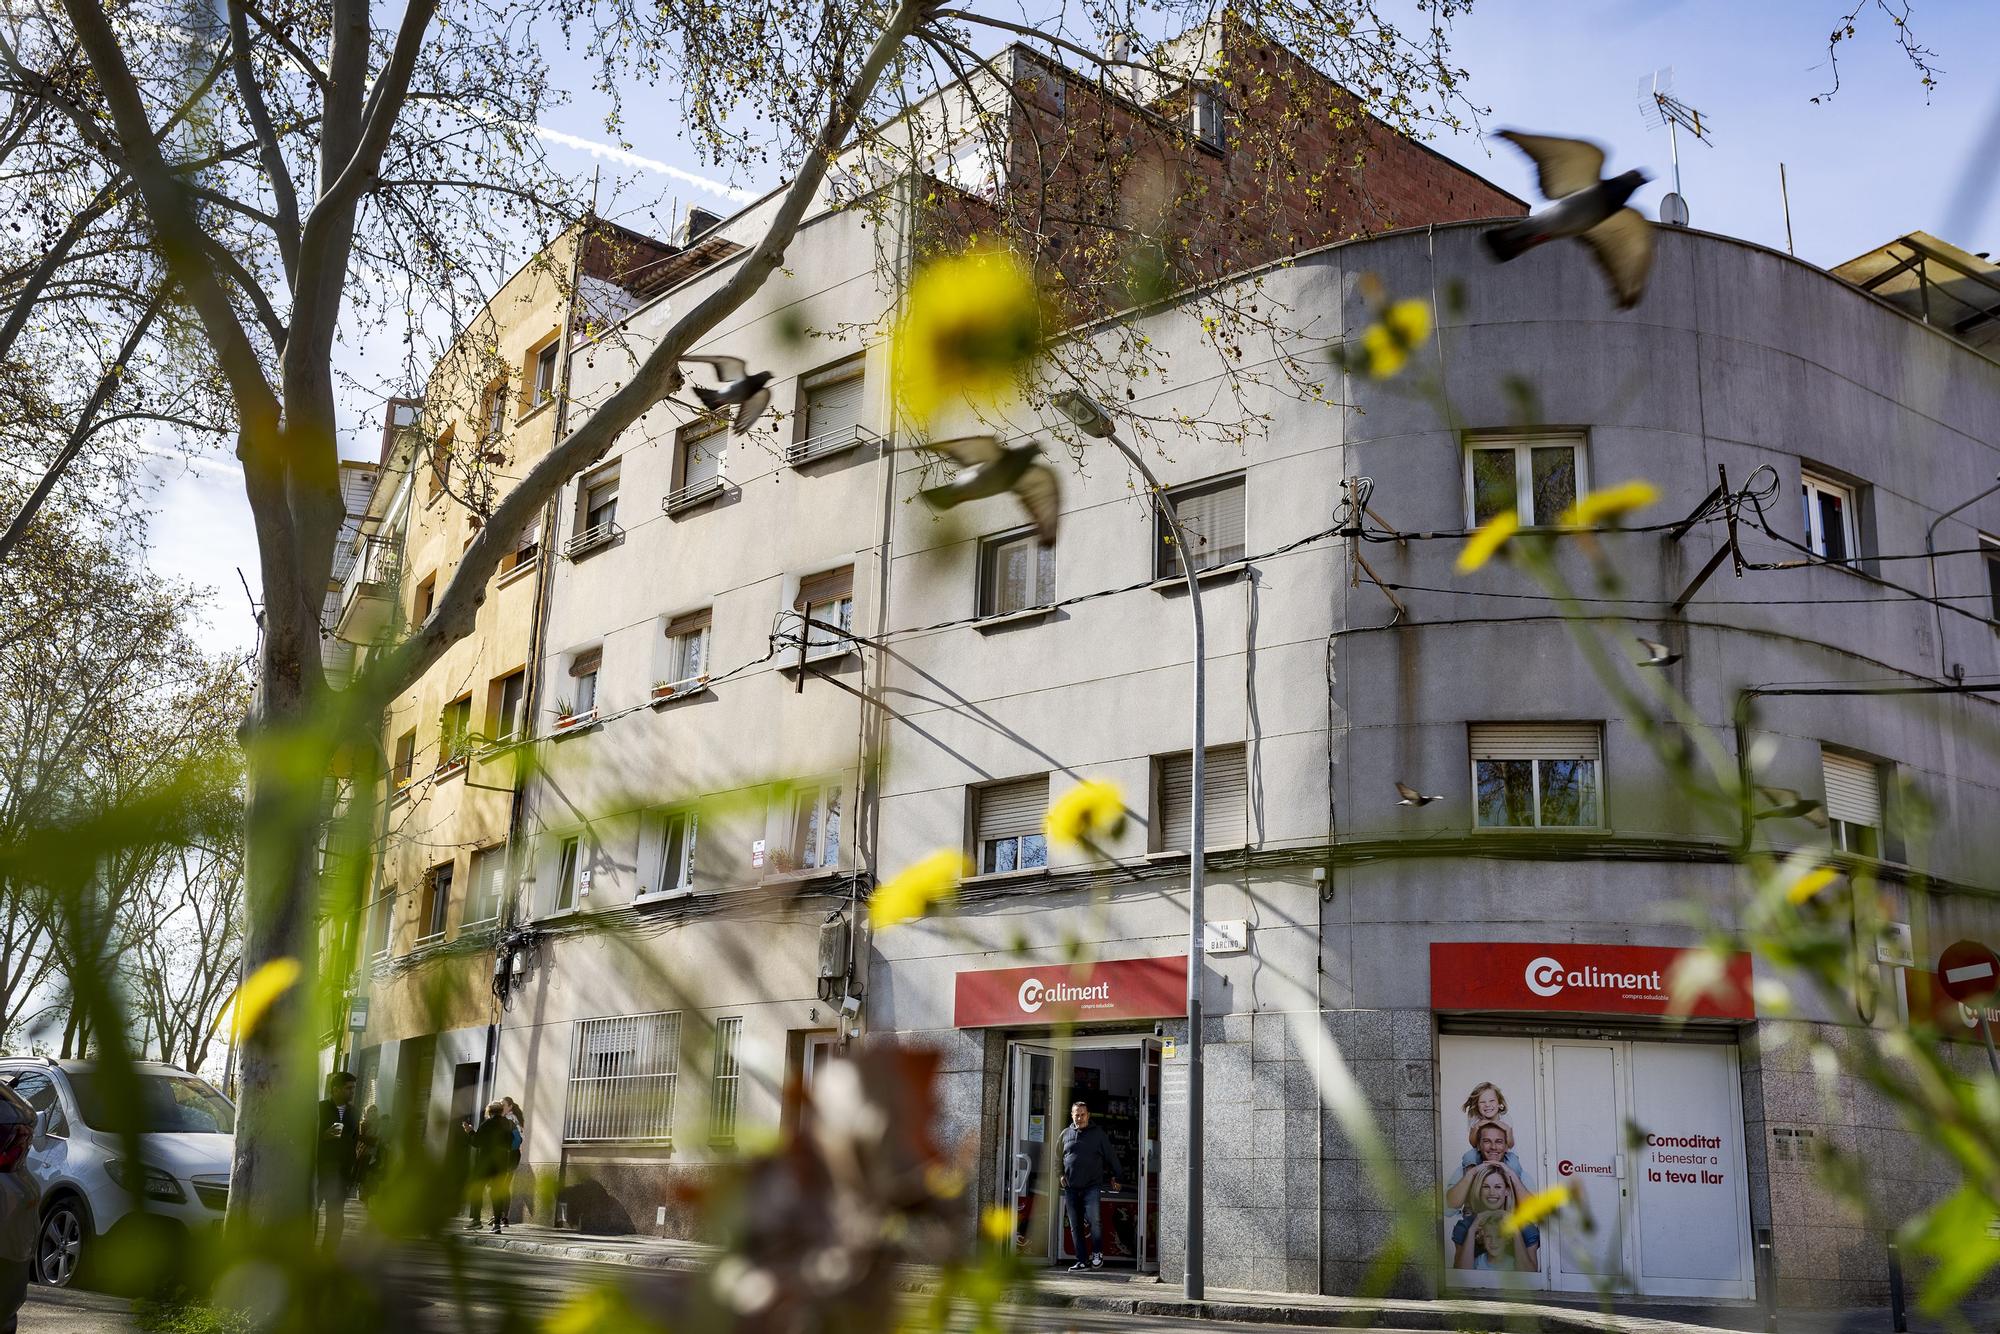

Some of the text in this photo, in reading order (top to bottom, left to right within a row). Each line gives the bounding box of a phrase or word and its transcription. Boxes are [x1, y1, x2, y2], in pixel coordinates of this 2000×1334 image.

[1211, 940, 1239, 950] BARCINO
[1646, 1133, 1722, 1149] Comoditat
[1652, 1151, 1718, 1165] i benestar a
[1648, 1168, 1724, 1185] la teva llar
